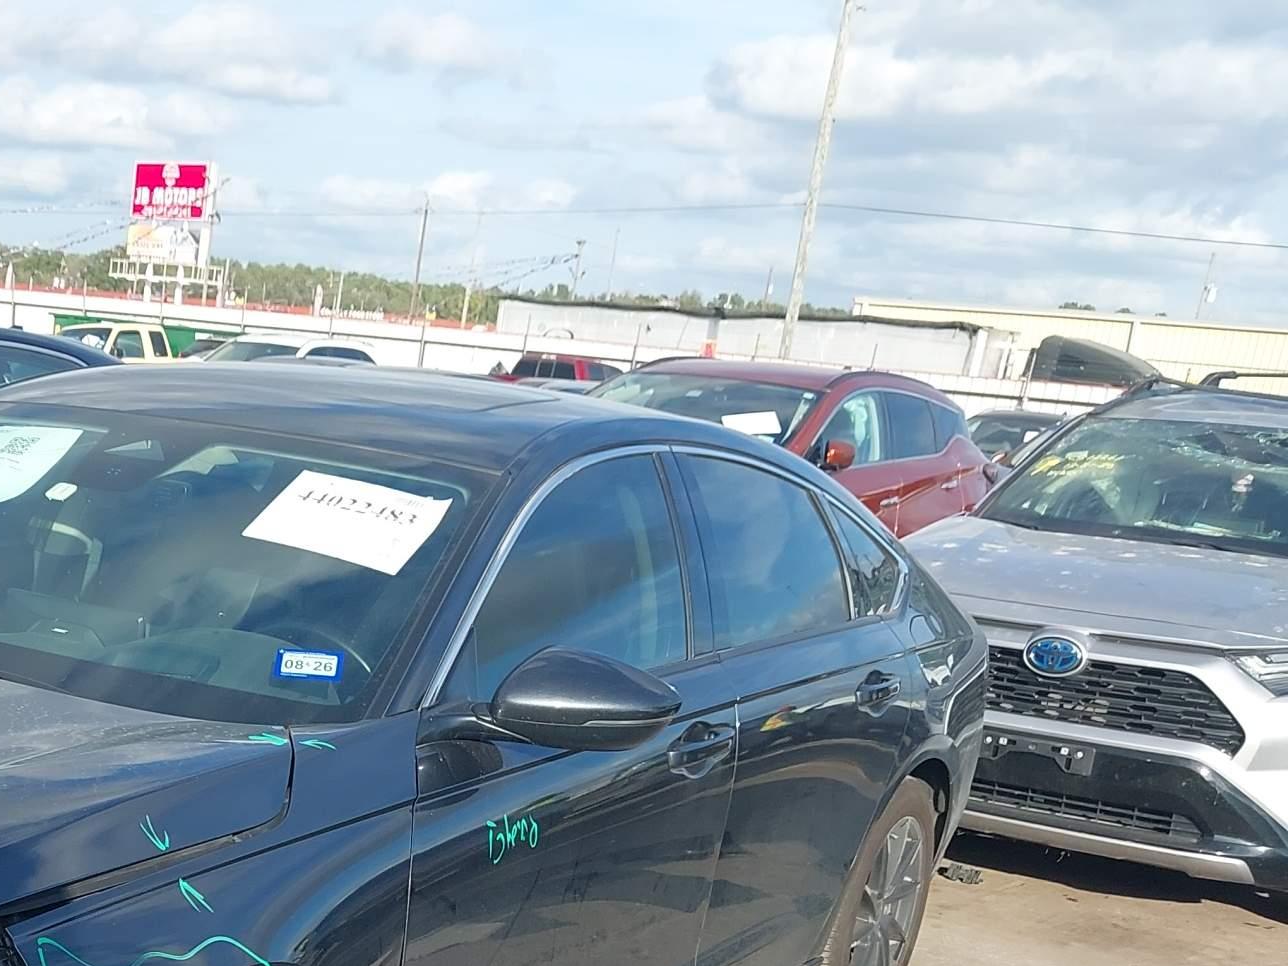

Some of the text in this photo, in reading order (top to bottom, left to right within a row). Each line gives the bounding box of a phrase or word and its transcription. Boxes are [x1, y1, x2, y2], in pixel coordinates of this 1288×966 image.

[152, 187, 203, 207] MOTORS
[298, 490, 418, 524] 44022483
[284, 659, 334, 672] 08 26
